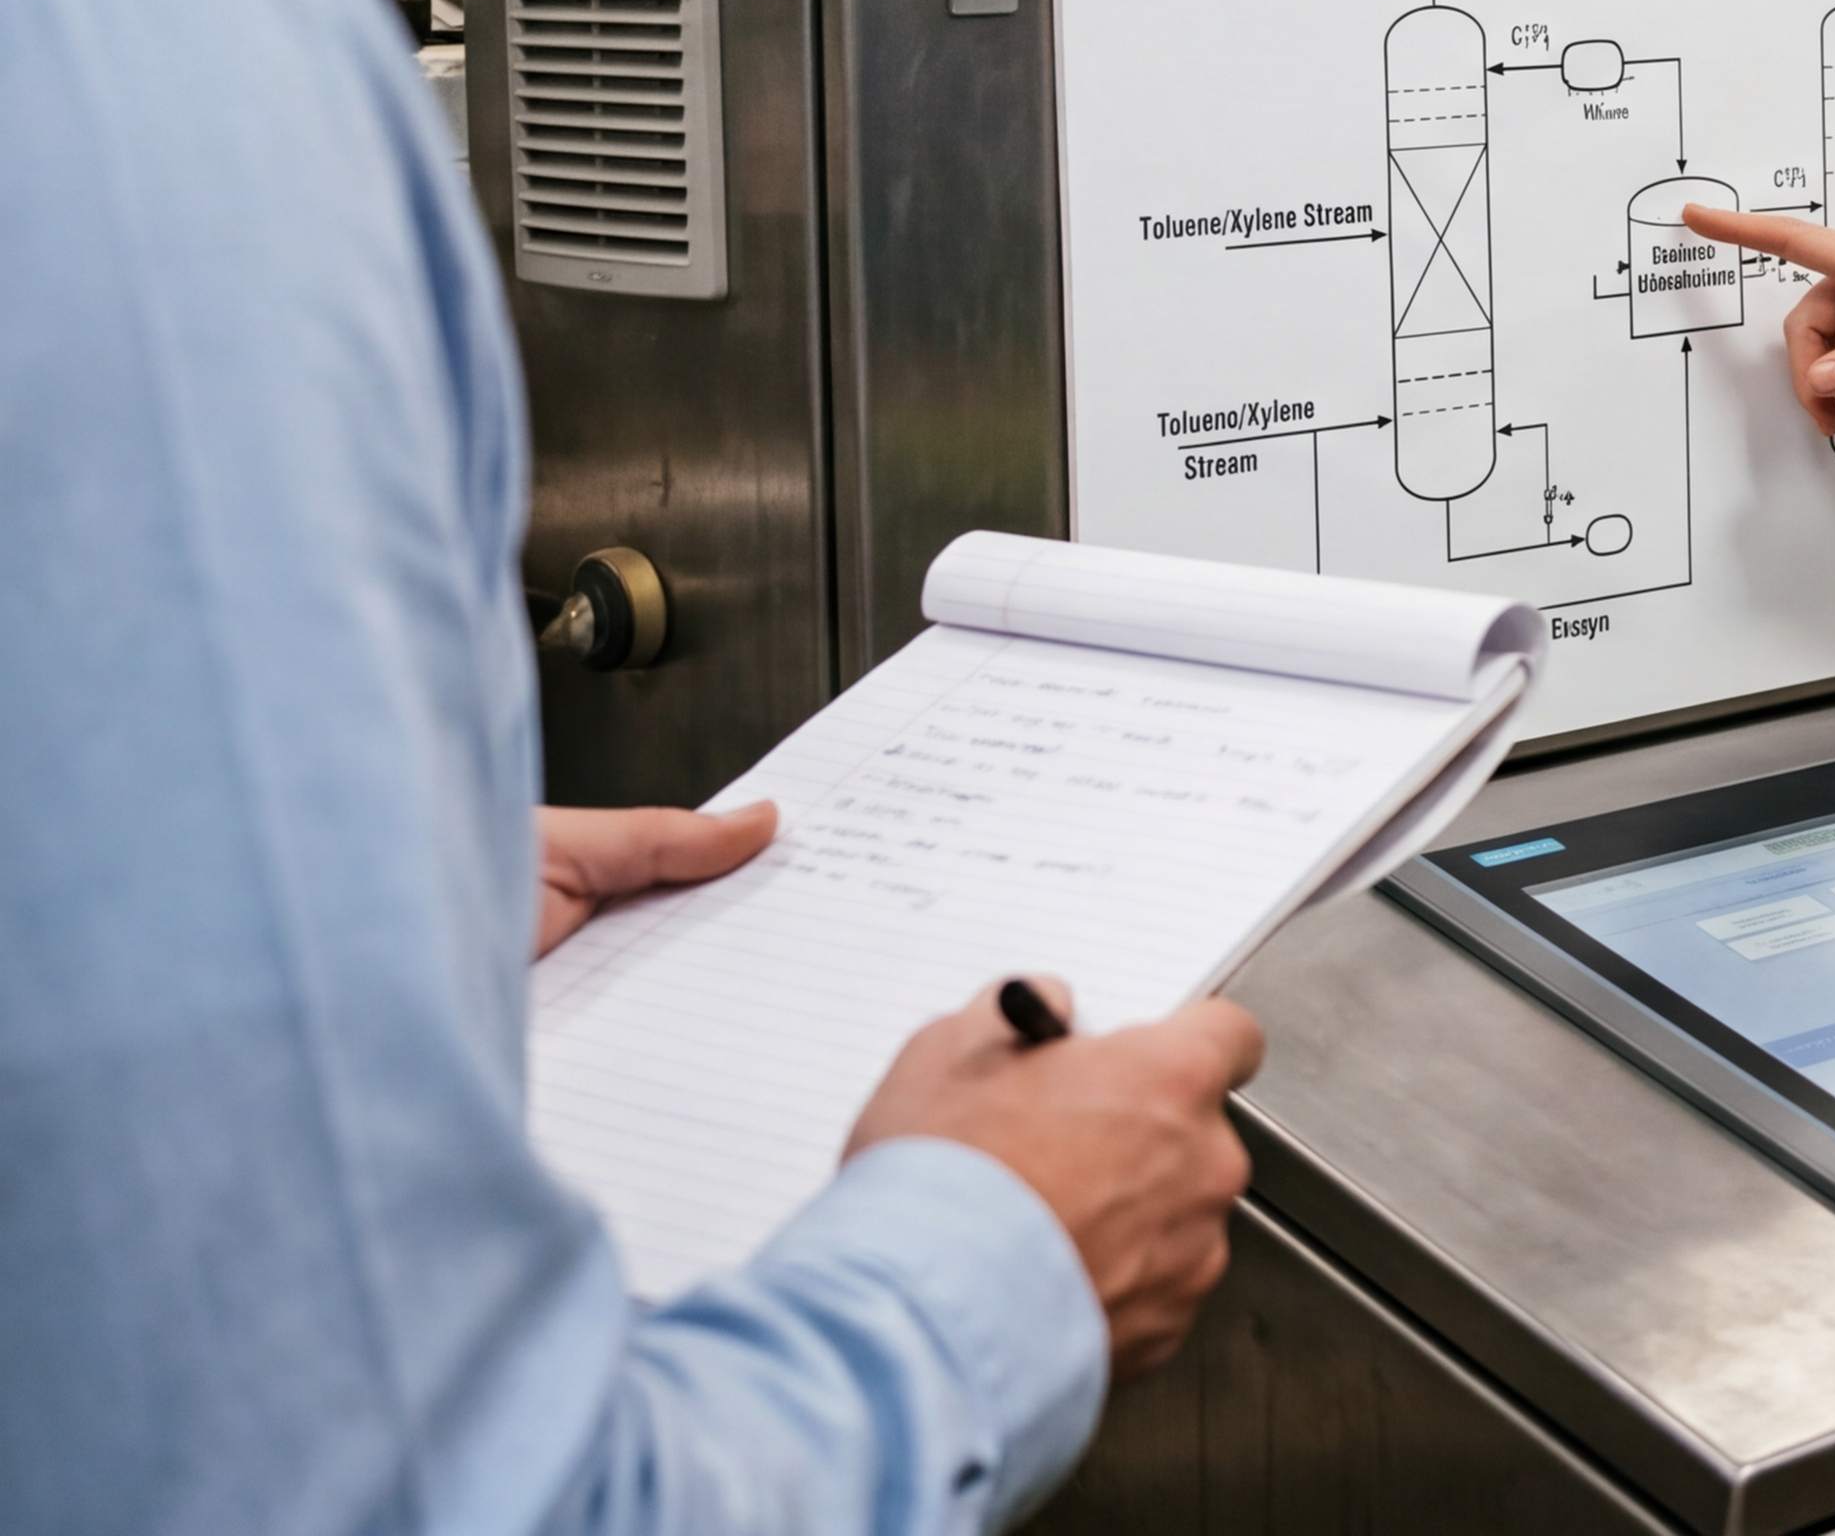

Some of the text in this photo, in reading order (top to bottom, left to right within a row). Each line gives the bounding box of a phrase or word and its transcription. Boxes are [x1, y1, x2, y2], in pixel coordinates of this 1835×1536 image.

[1139, 203, 1373, 241] Toluene/Xylene Stream
[1156, 399, 1315, 438] Tolueno/Xylene
[1184, 453, 1258, 481] Stream
